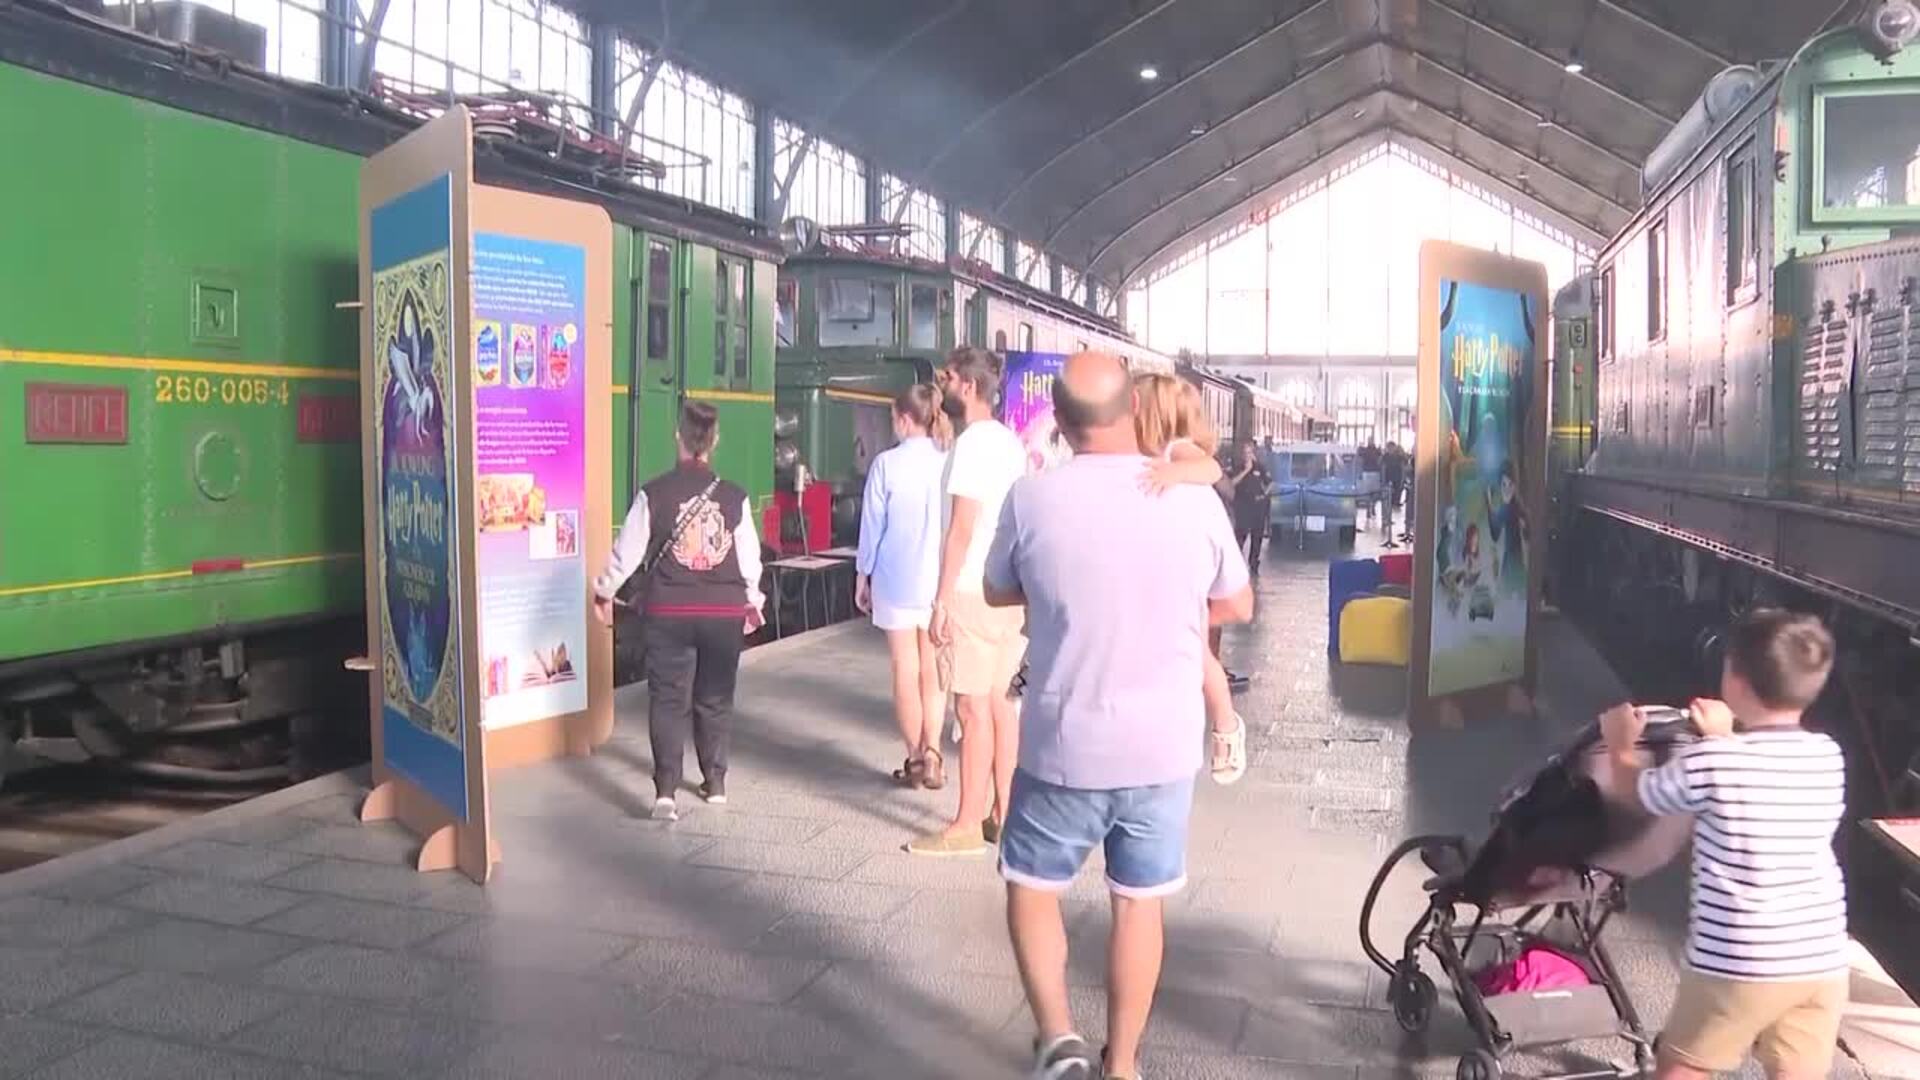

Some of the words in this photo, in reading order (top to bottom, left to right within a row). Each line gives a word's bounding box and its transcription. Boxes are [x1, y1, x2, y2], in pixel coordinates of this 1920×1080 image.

[1451, 333, 1489, 381] Harry
[1019, 369, 1054, 410] Harr
[387, 485, 413, 547] Harry
[412, 479, 443, 546] Potter
